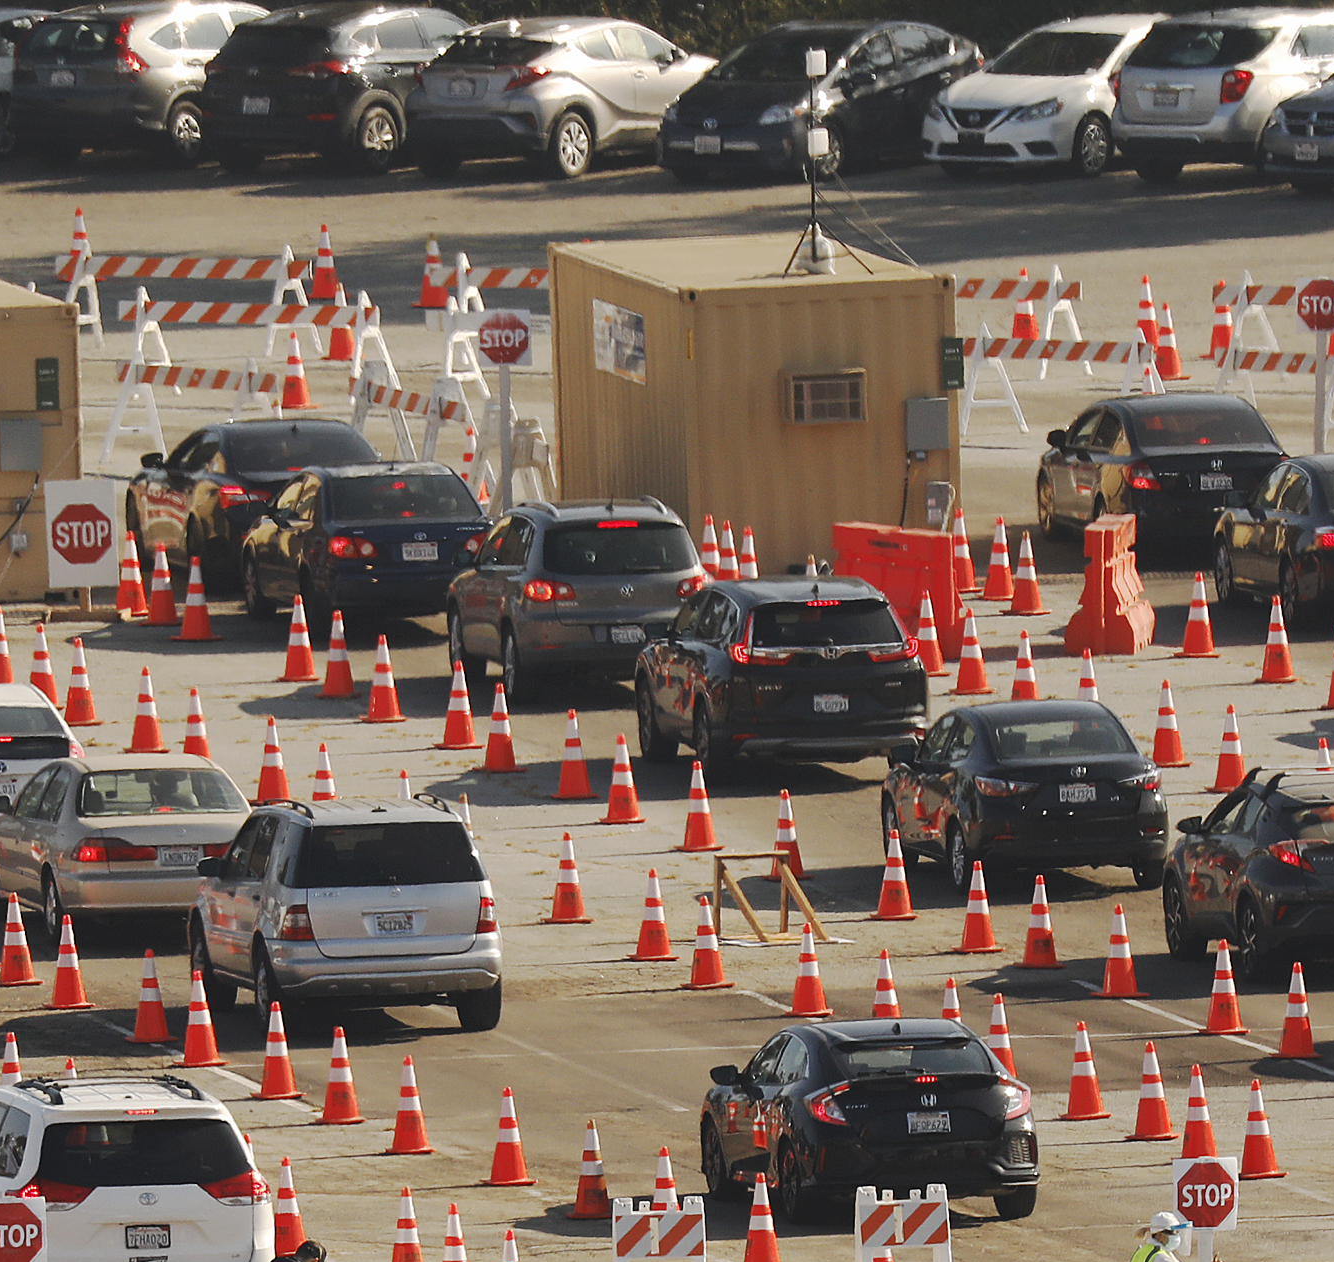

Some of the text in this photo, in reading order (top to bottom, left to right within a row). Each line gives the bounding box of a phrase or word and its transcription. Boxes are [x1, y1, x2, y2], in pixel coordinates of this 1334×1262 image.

[480, 328, 525, 349] STOP
[56, 520, 109, 549] STOP
[1181, 1183, 1233, 1208] STOP
